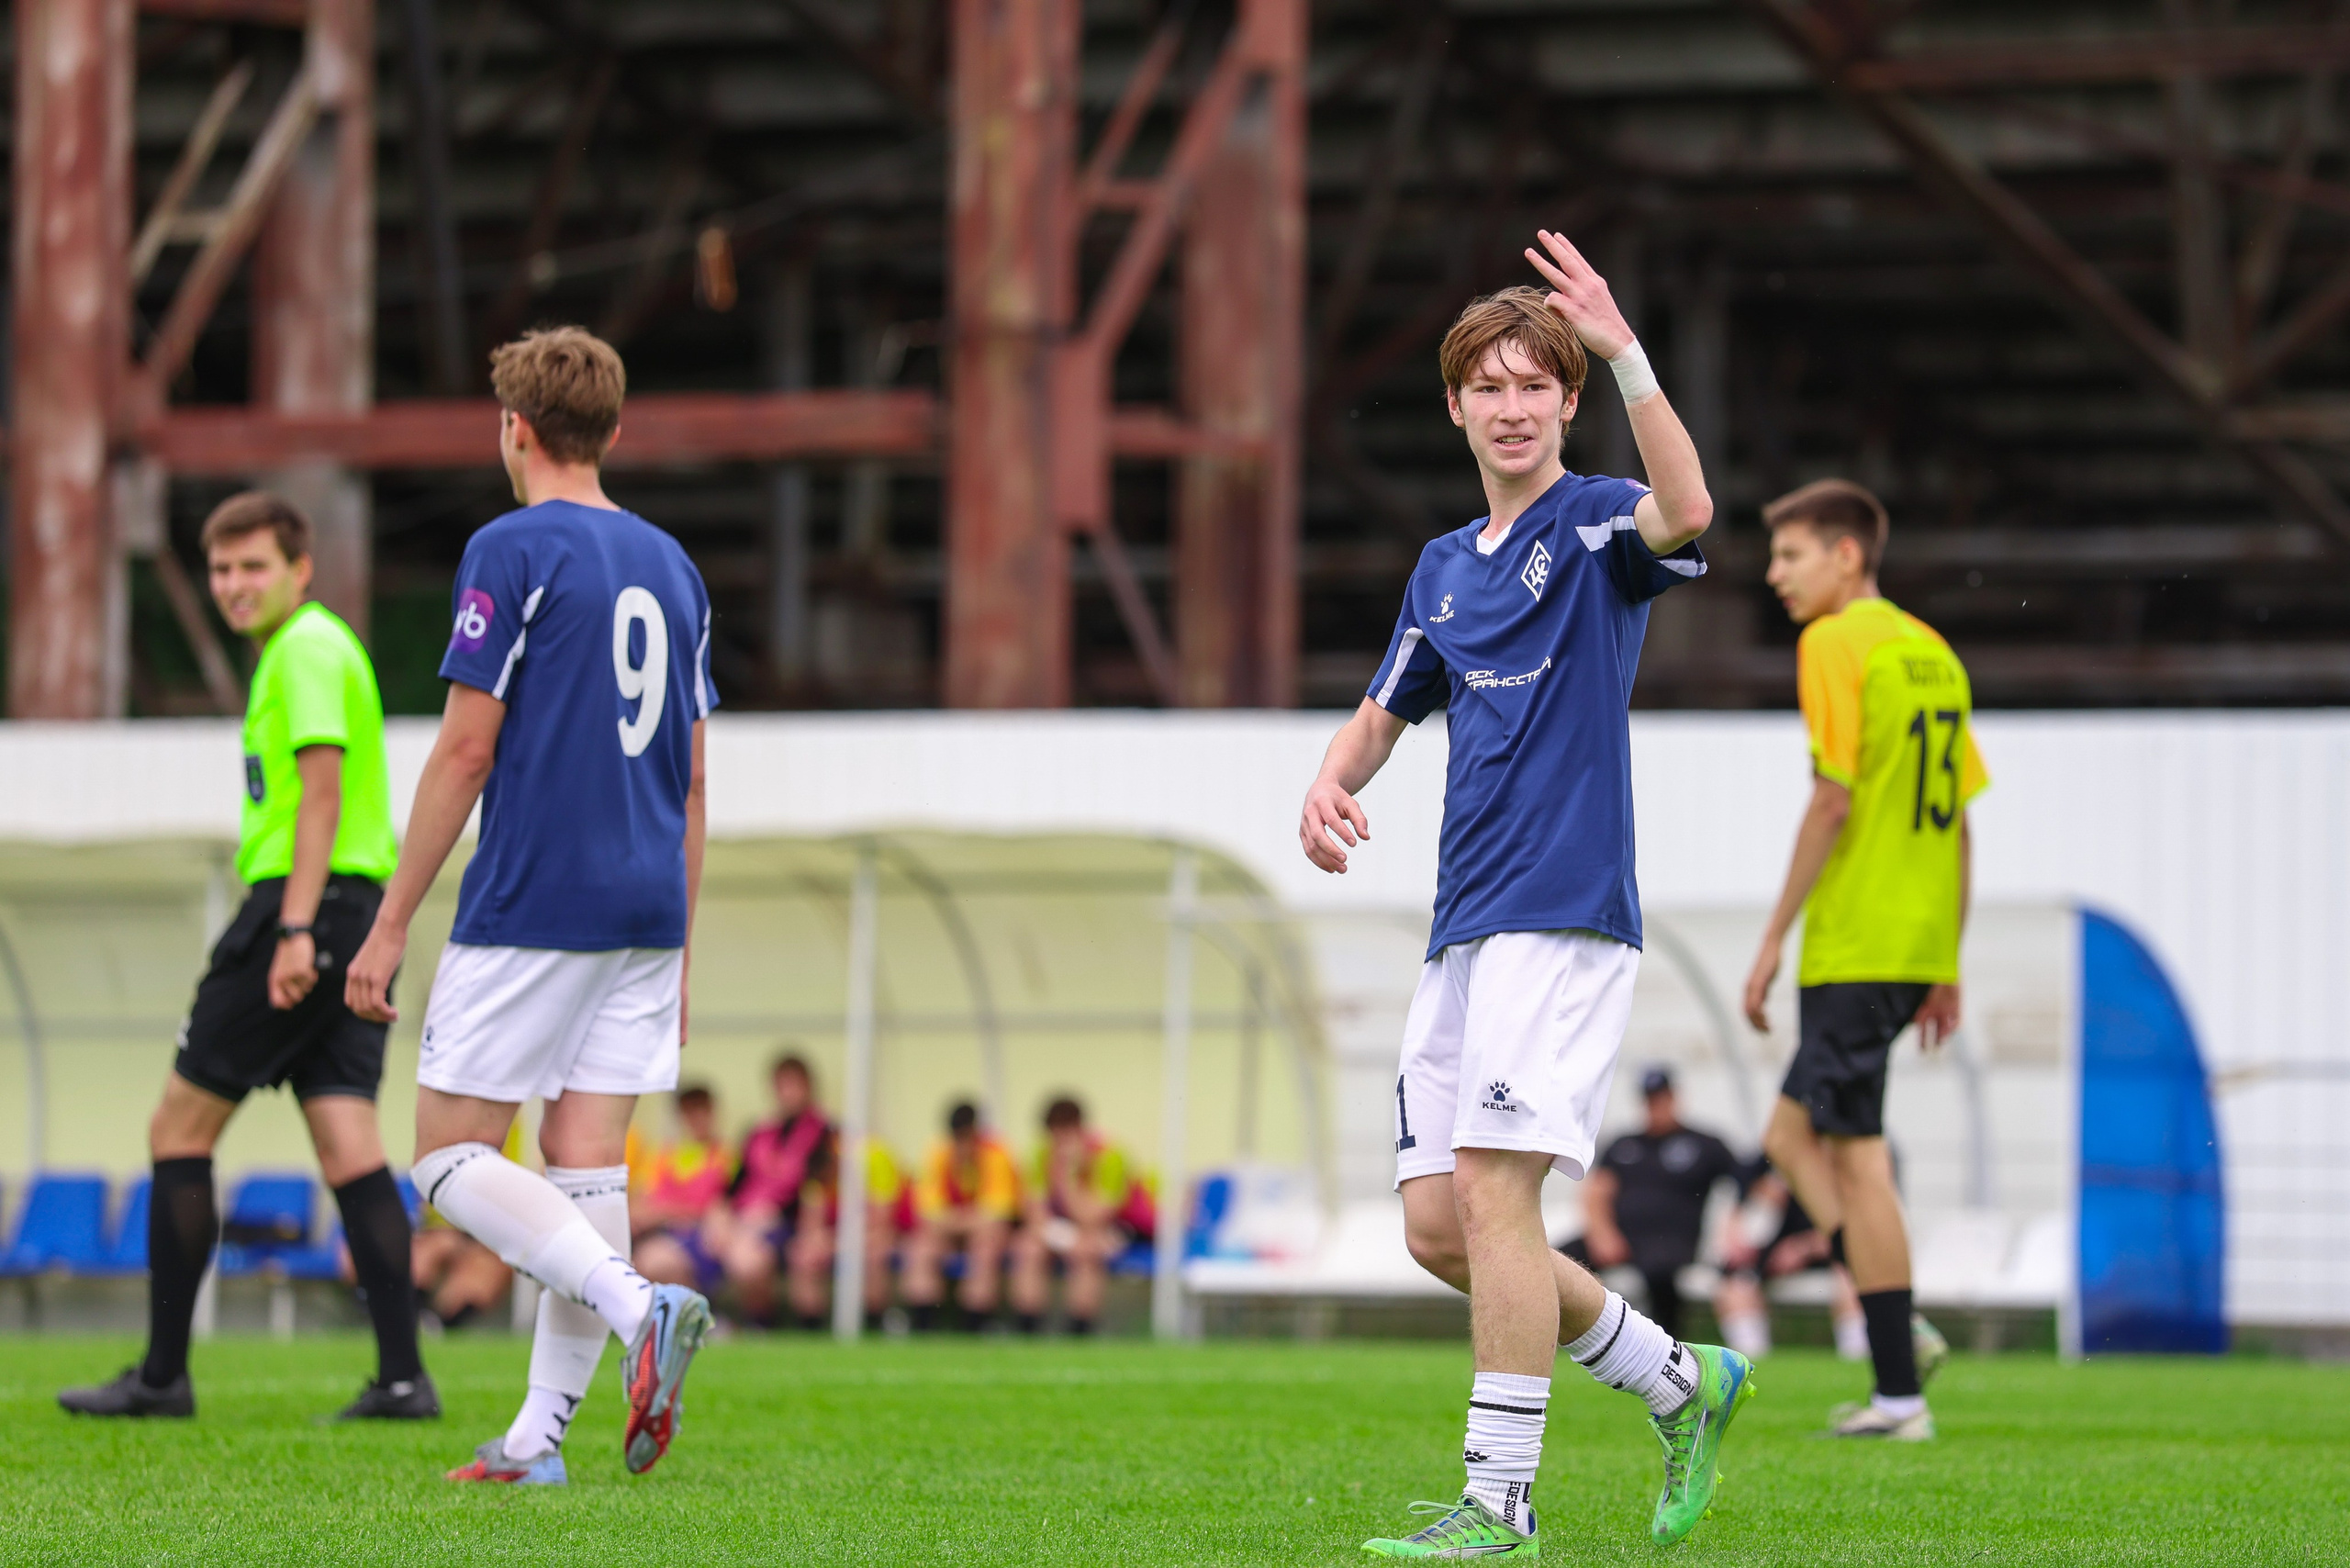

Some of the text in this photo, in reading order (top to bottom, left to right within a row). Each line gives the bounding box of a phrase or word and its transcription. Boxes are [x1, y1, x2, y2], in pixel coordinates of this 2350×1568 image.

[1429, 610, 1455, 622] KELME
[612, 586, 669, 758] 9
[1910, 709, 1961, 831] 13
[1482, 1102, 1517, 1113] KELME
[1661, 1364, 1695, 1397] DESIGN
